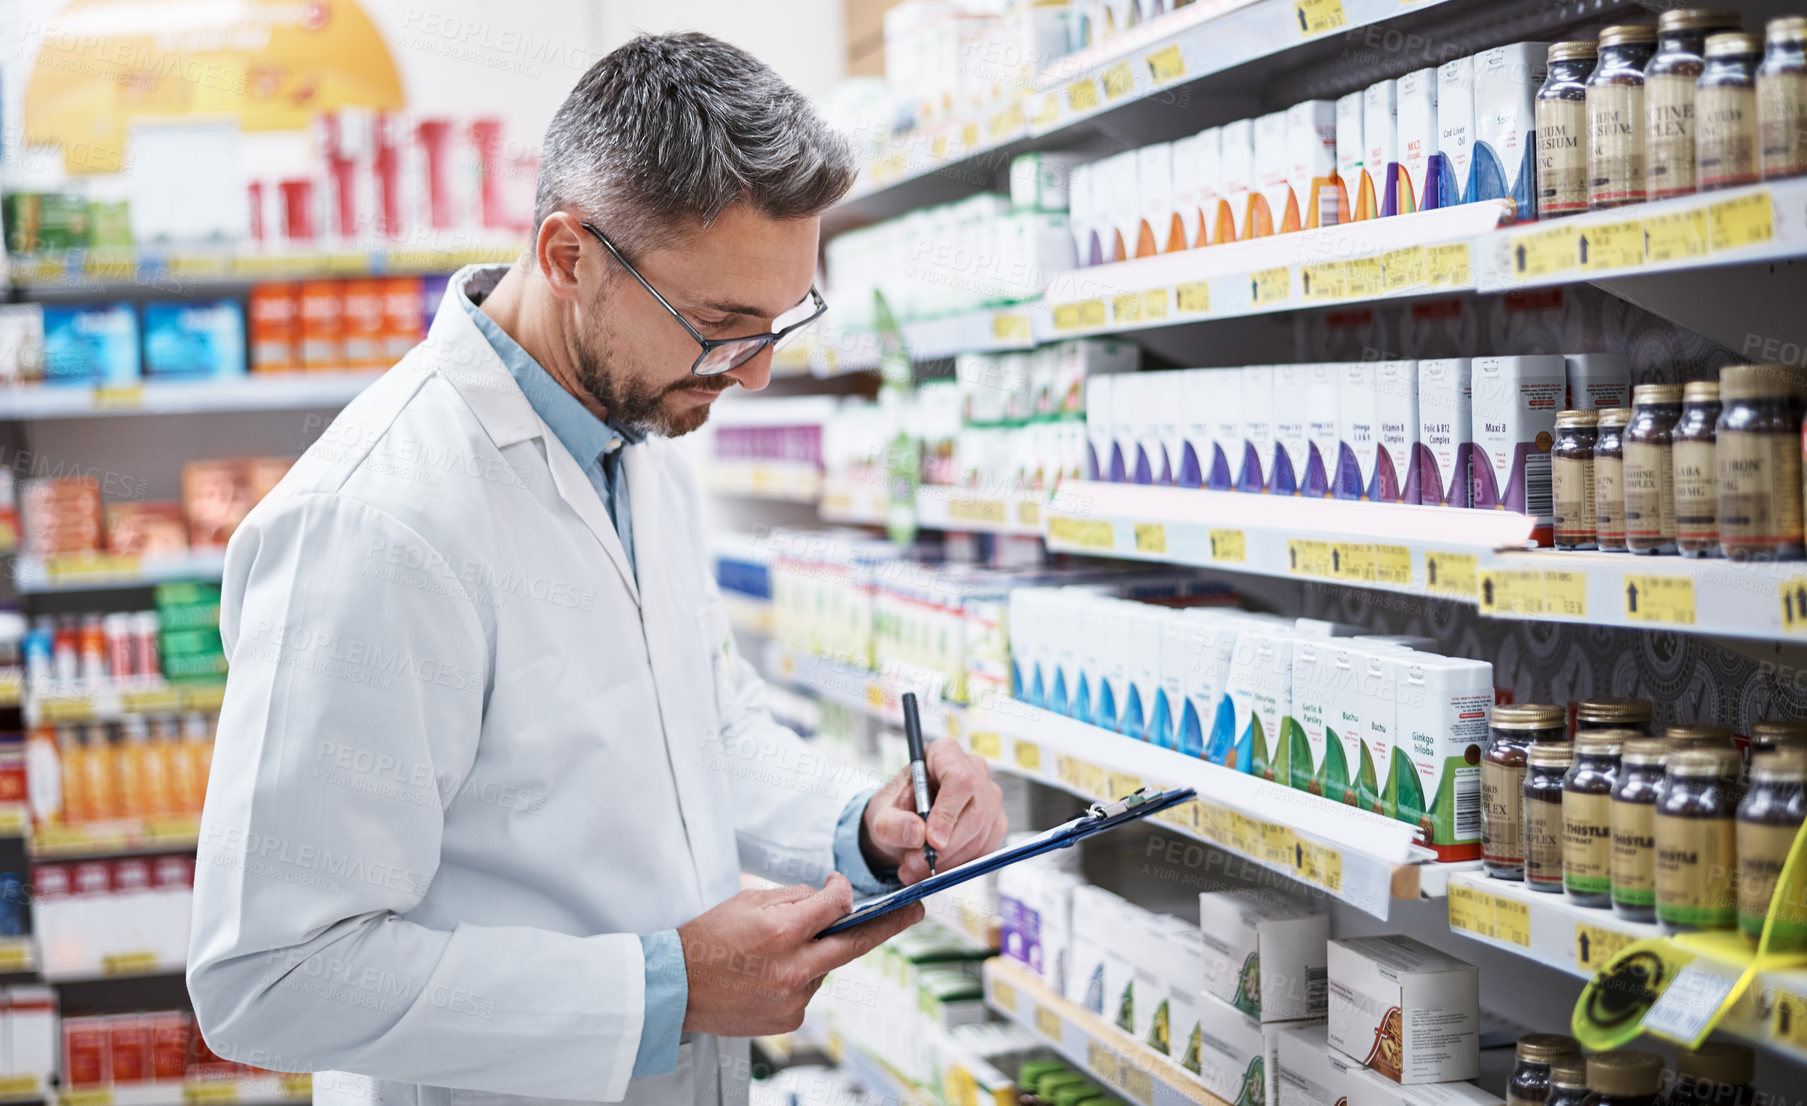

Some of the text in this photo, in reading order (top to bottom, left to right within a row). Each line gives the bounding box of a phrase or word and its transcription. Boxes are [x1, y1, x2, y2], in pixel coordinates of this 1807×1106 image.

[1444, 126, 1465, 138] Cod Liver
[1382, 424, 1400, 432] Vitamin
[1424, 424, 1435, 432] Folic
[1441, 424, 1450, 433] B12
[1486, 424, 1506, 432] Maxi B
[1384, 434, 1404, 444] Complex
[1430, 435, 1450, 446] Complex
[1474, 478, 1483, 502] B
[1302, 703, 1317, 713] Garlic
[1304, 714, 1322, 727] Parsley
[1342, 711, 1358, 722] Buchu
[1371, 721, 1386, 733] Buchu
[1412, 731, 1434, 745] Ginkgo
[1414, 744, 1434, 756] biloba
[1566, 823, 1610, 838] THISTLE
